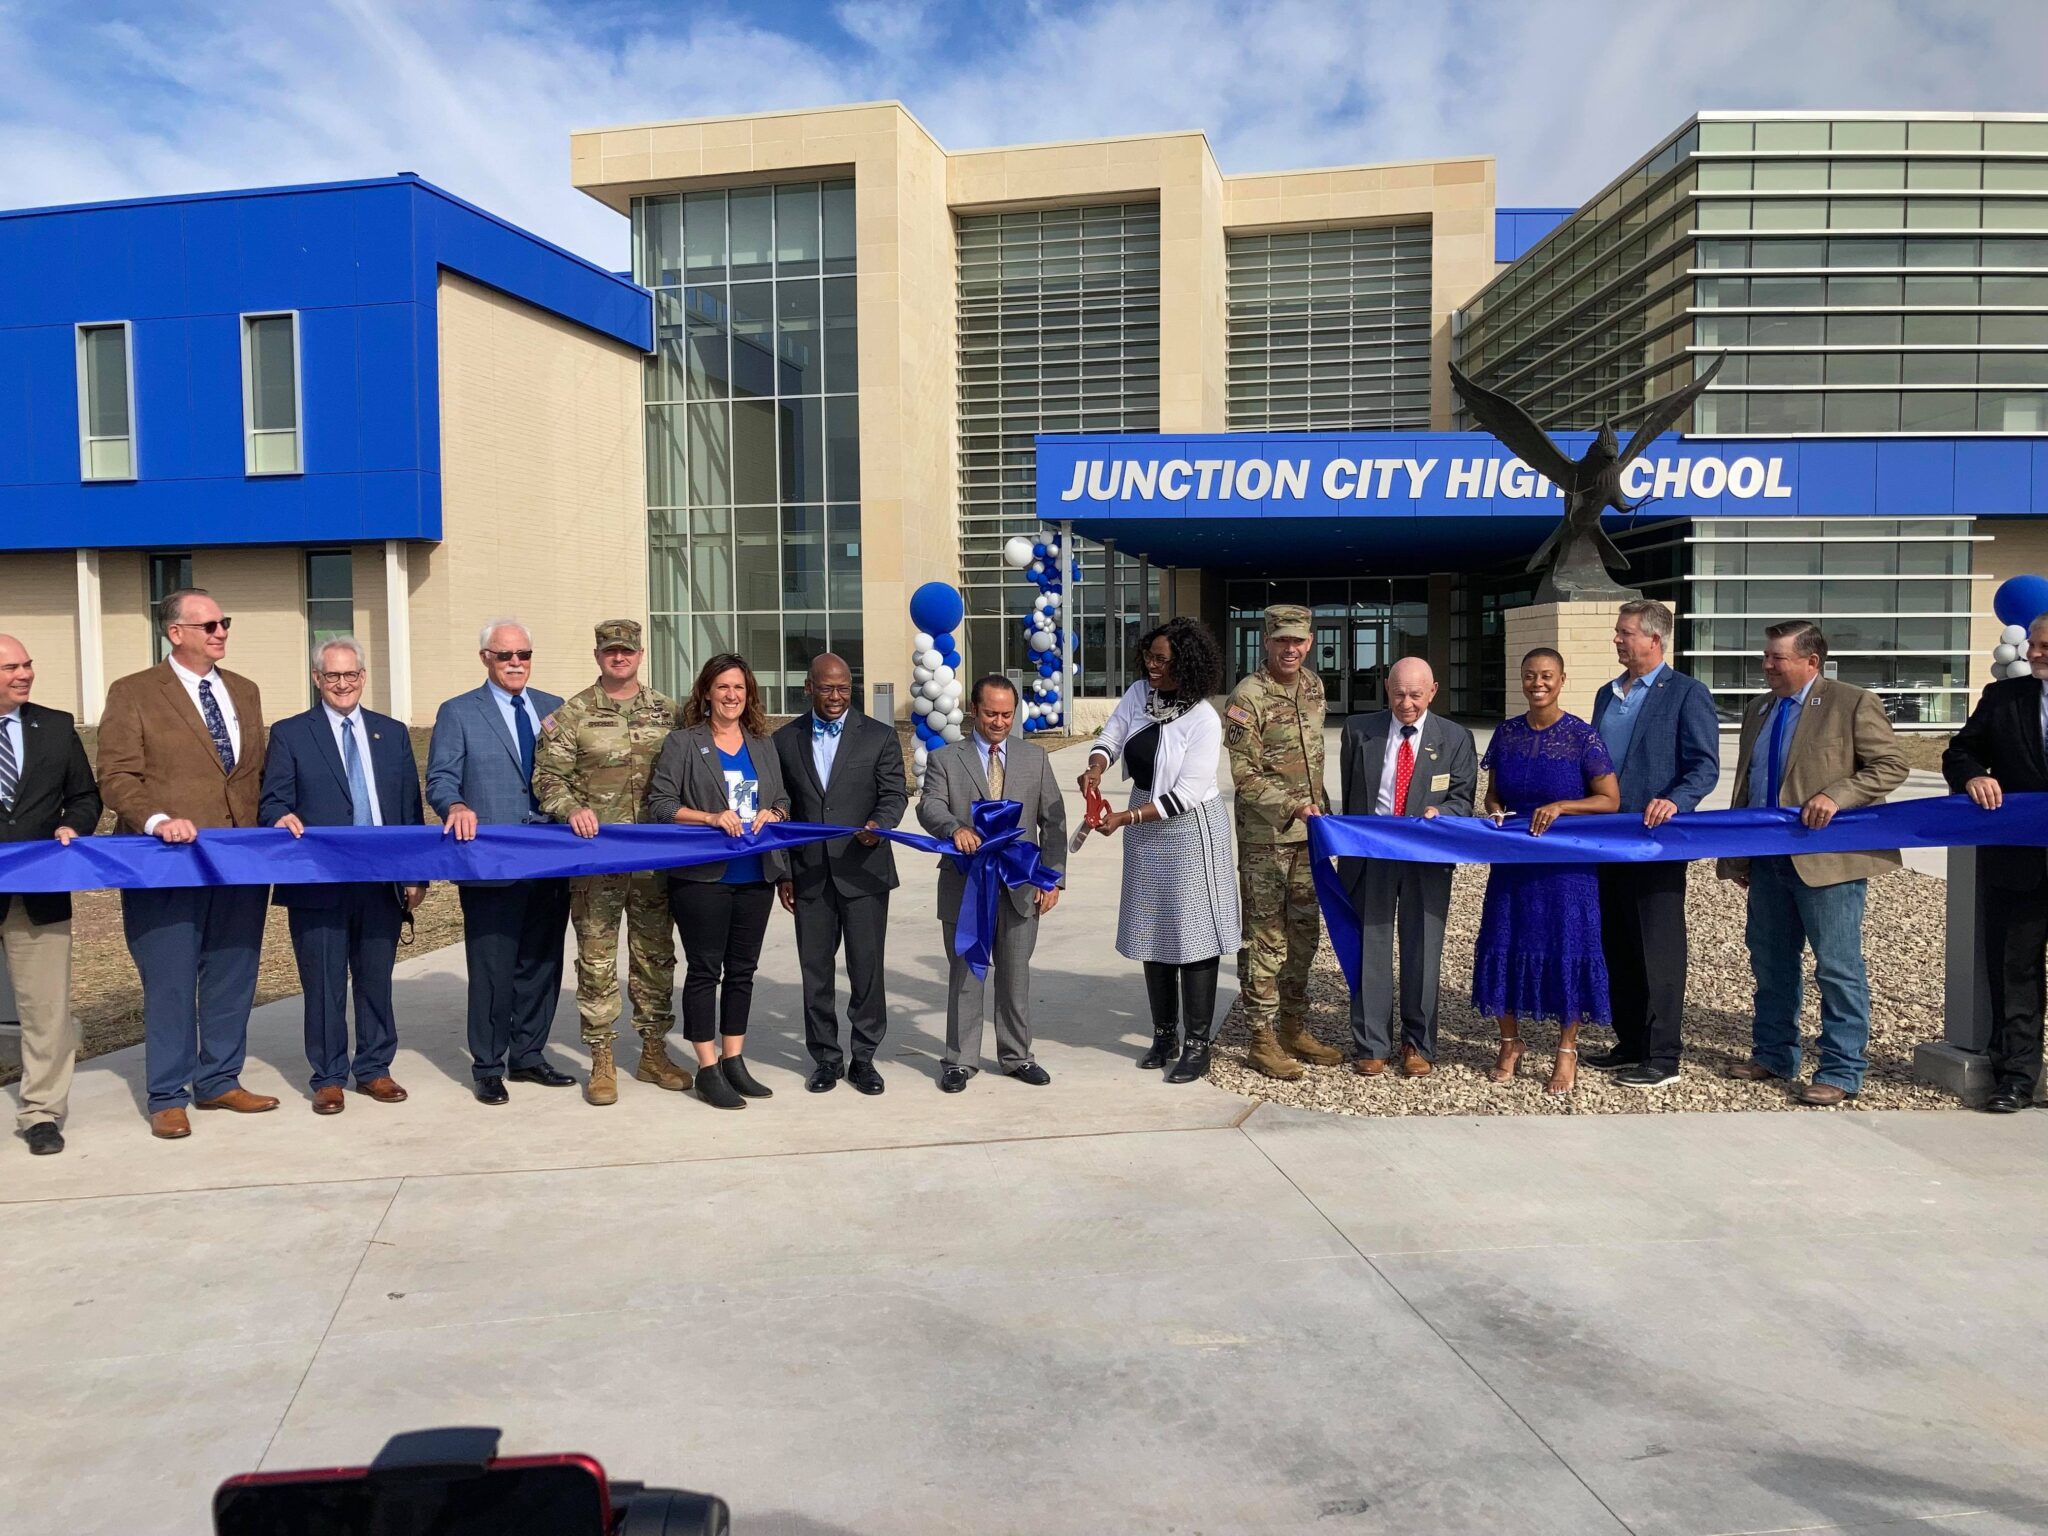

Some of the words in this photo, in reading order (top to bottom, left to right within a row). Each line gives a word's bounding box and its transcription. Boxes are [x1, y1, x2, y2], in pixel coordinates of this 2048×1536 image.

[1061, 459, 1311, 501] JUNCTION
[1322, 458, 1439, 500] CITY
[1619, 457, 1792, 499] CHOOL
